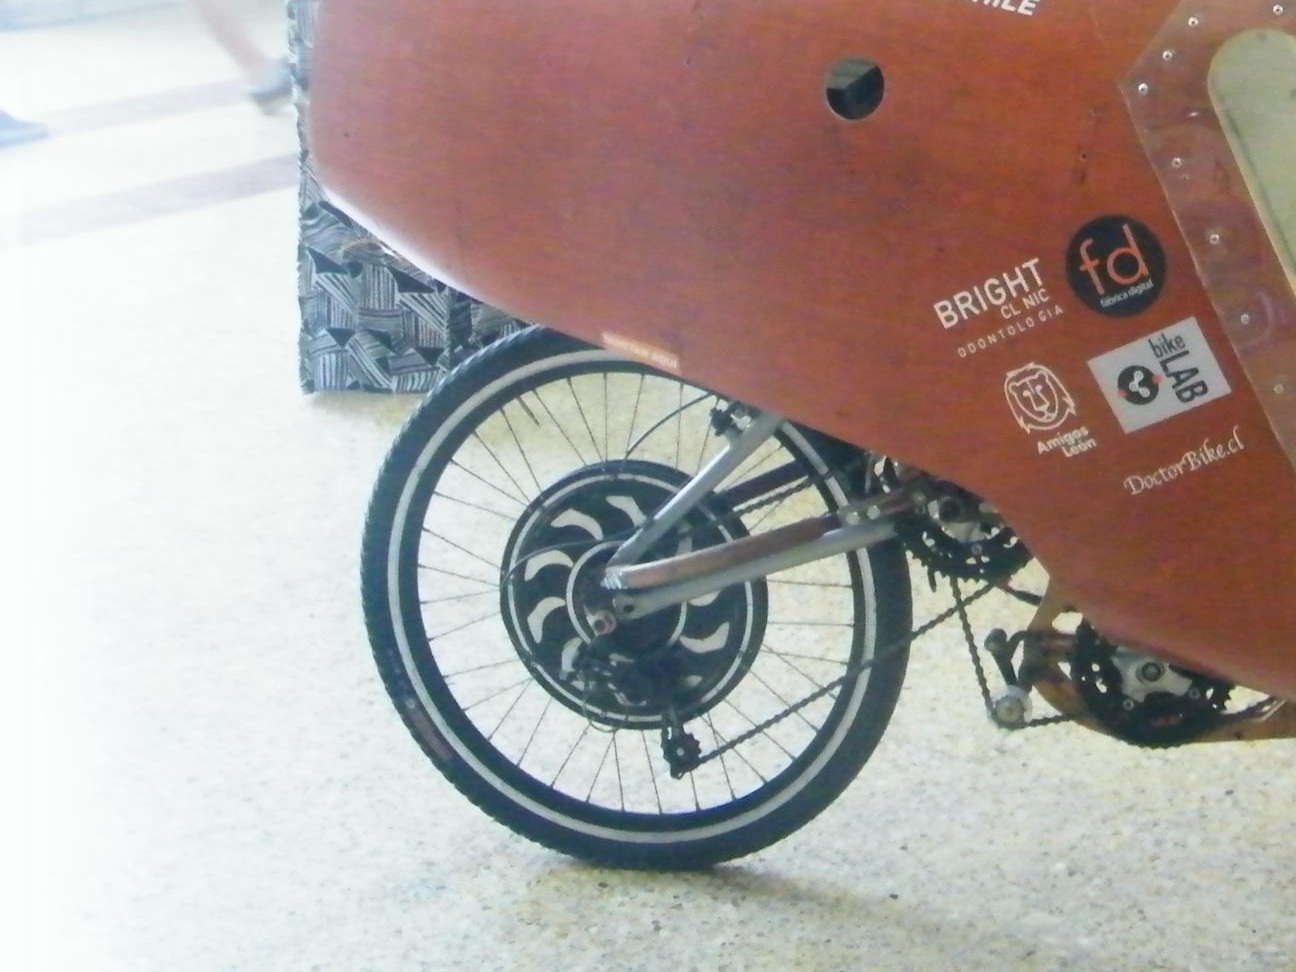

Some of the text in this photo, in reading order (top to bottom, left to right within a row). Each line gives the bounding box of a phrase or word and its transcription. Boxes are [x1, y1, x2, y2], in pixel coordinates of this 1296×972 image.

[933, 256, 1044, 330] BRIGHT
[1127, 278, 1155, 298] digital
[1148, 332, 1187, 359] bike
[1159, 349, 1209, 404] LAB
[1036, 424, 1090, 455] Amigos
[1123, 424, 1246, 496] DoctorBike.cl
